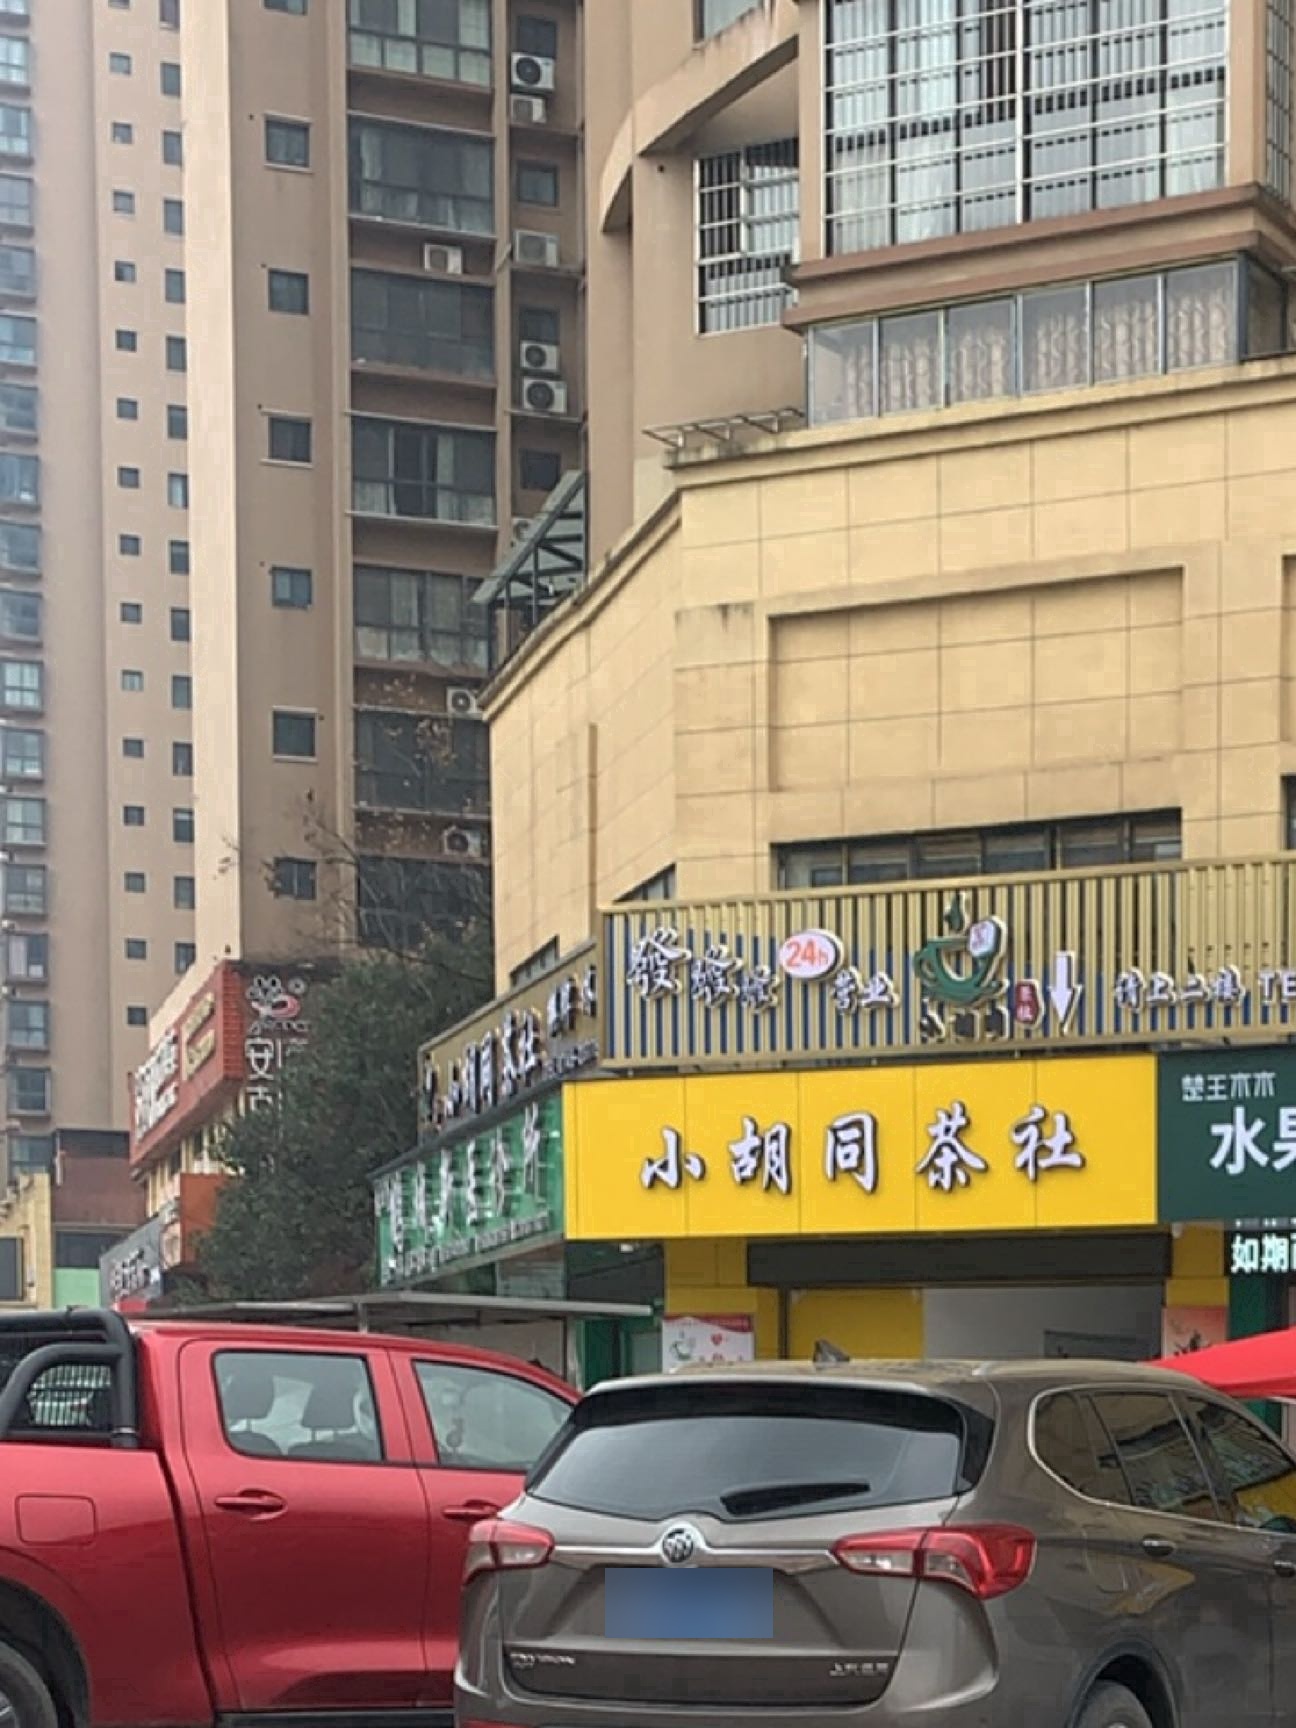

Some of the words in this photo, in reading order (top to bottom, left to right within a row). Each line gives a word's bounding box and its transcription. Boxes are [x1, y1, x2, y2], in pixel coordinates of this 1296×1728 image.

[784, 940, 829, 968] 24h
[1181, 1071, 1277, 1102] 楚王木木
[641, 1101, 1087, 1194] 小胡同茶社
